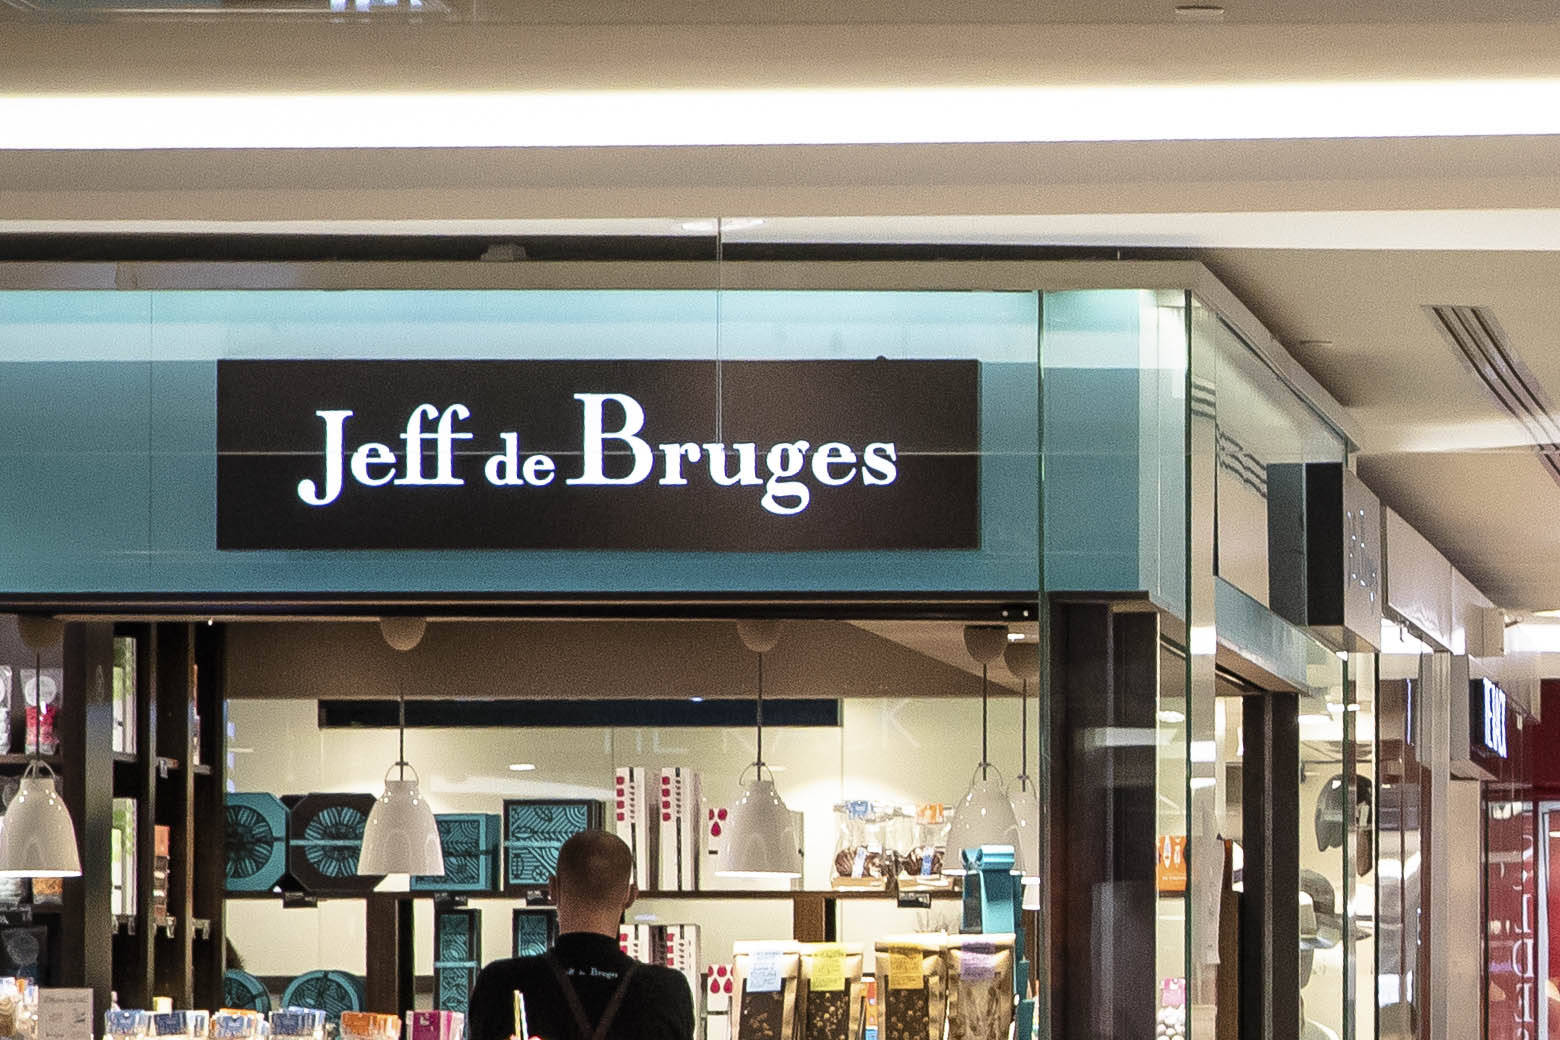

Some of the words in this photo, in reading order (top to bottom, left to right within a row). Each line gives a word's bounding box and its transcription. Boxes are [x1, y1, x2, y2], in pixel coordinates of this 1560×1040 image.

[297, 402, 474, 506] Jeff
[484, 432, 556, 487] de
[565, 392, 898, 515] Bruges
